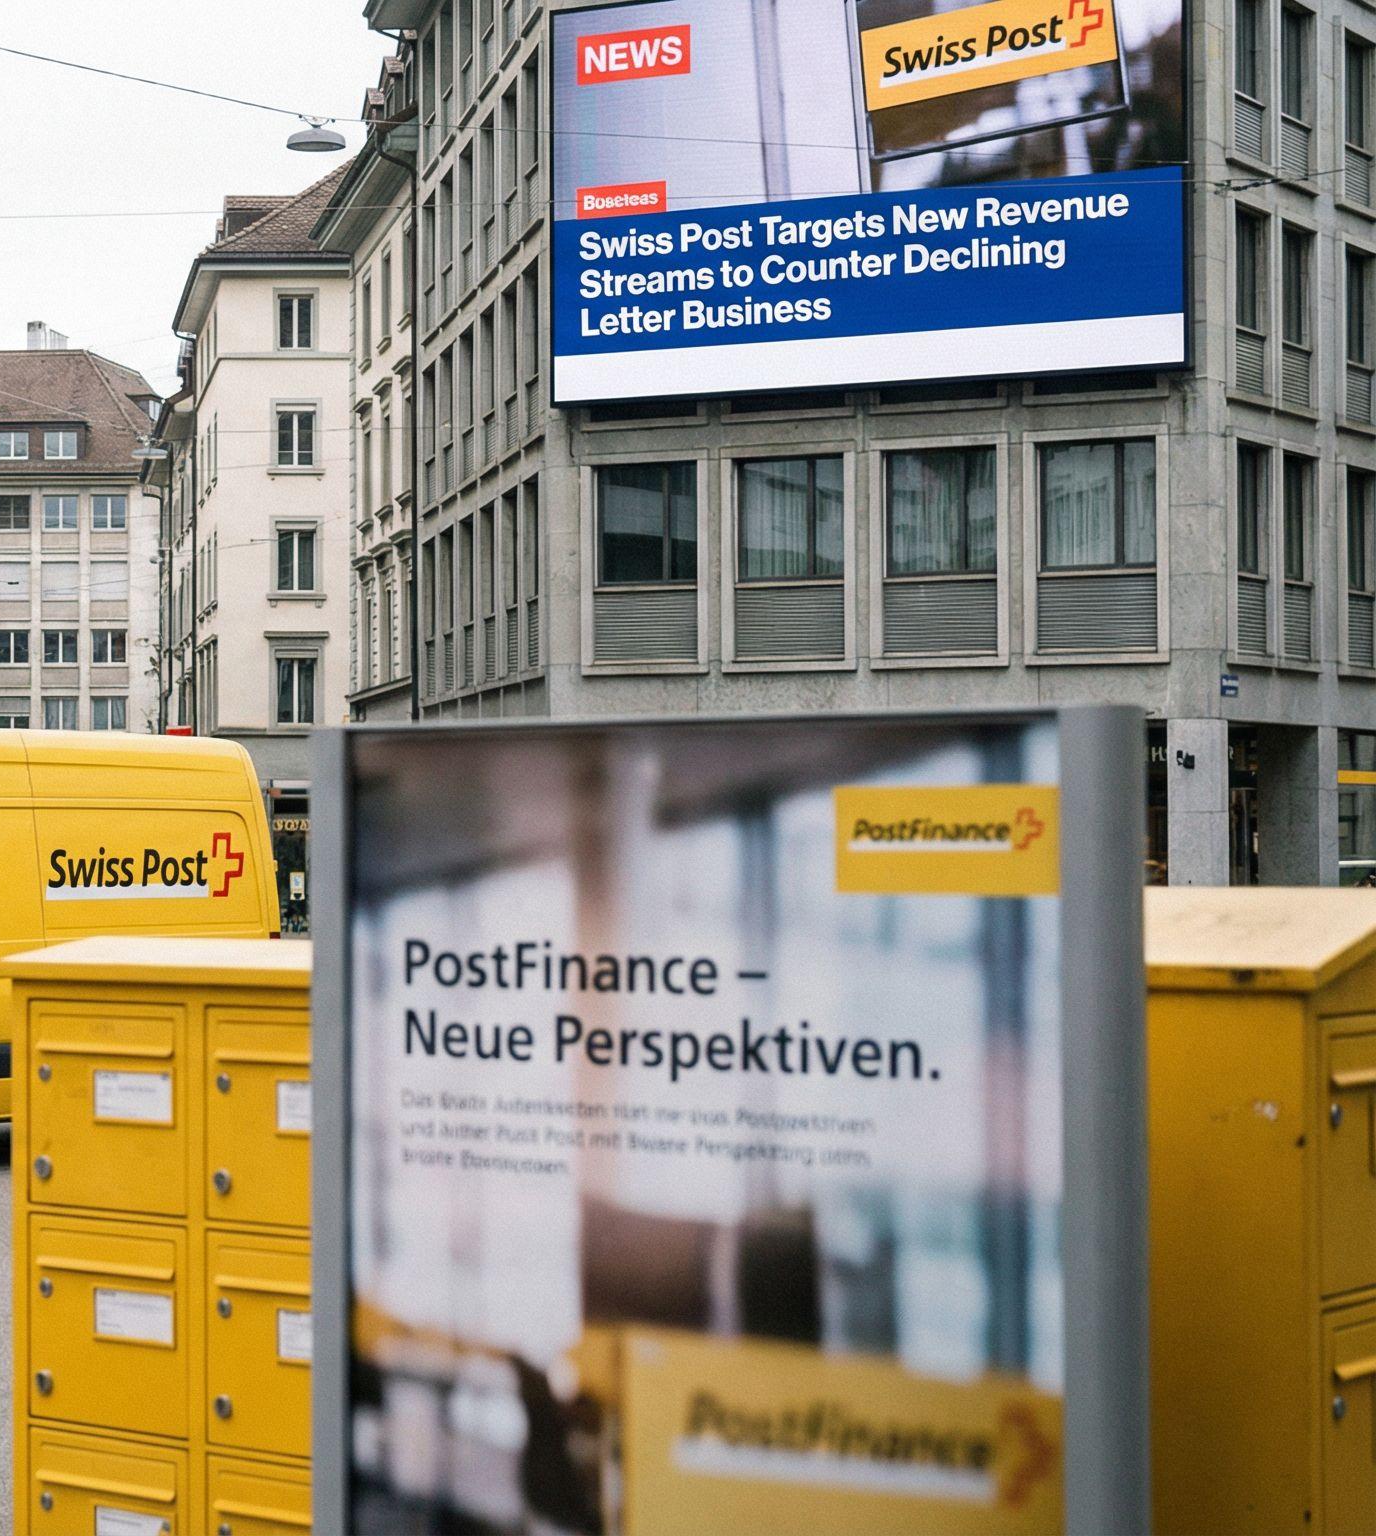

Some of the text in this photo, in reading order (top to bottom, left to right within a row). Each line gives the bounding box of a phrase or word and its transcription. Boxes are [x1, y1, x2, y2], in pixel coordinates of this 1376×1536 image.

[584, 36, 683, 74] NEWS
[883, 15, 1063, 78] Swiss Post
[579, 193, 1129, 261] Swiss Post Targets New Revenue
[579, 235, 1066, 299] Streams to Counter Declining
[581, 296, 832, 337] Letter Business
[851, 818, 1011, 842] PostFinance
[48, 846, 208, 888] Swiss Post
[405, 939, 718, 996] PostFinance
[405, 1008, 940, 1083] Neue Perspektiven.
